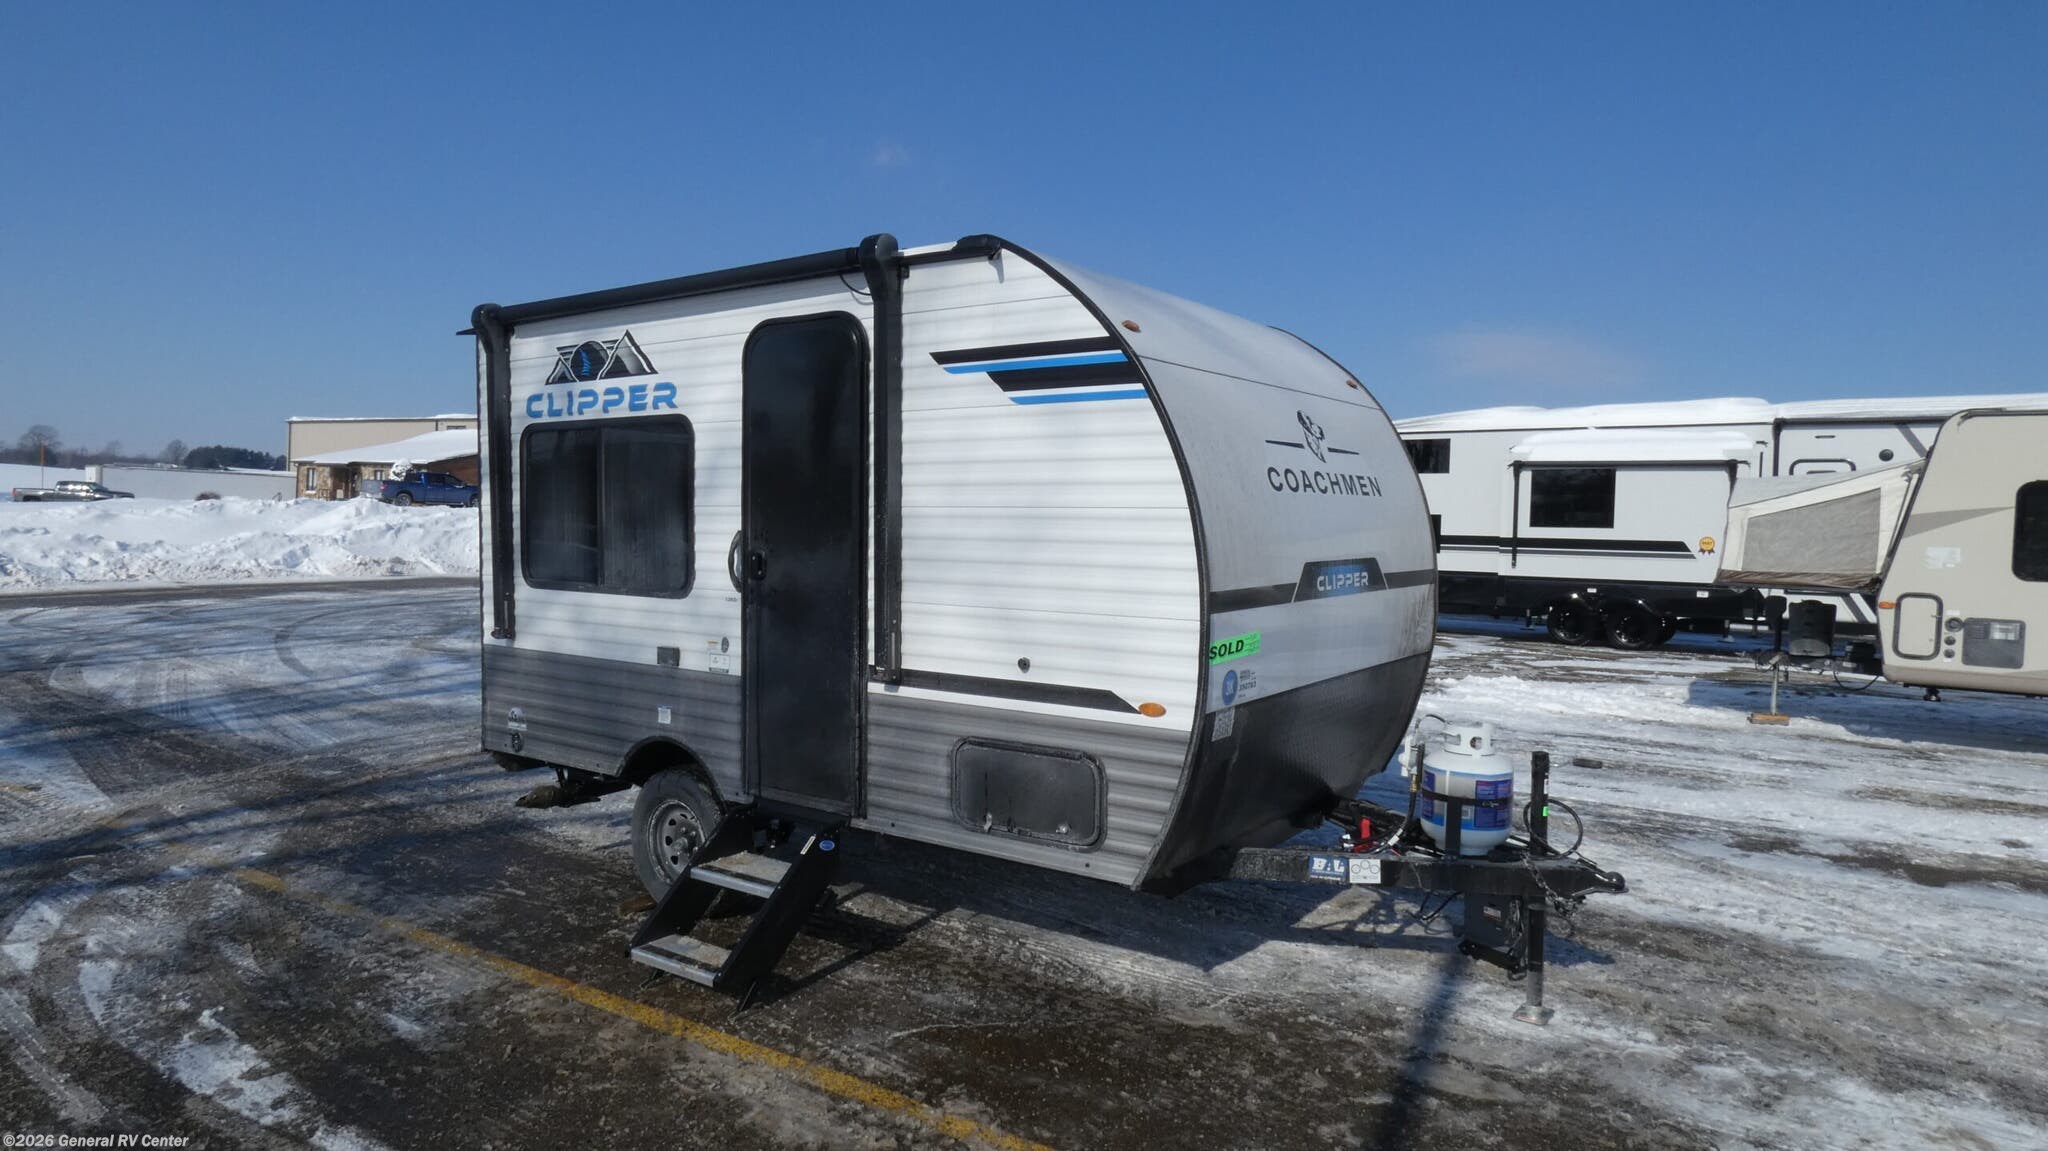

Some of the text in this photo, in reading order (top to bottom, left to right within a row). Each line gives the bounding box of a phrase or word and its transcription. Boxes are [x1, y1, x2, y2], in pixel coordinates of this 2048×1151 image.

[526, 382, 678, 419] CLIPPER
[1267, 466, 1382, 497] COACHMEN
[1316, 571, 1369, 592] CLIPPER
[1209, 639, 1244, 660] SOLD
